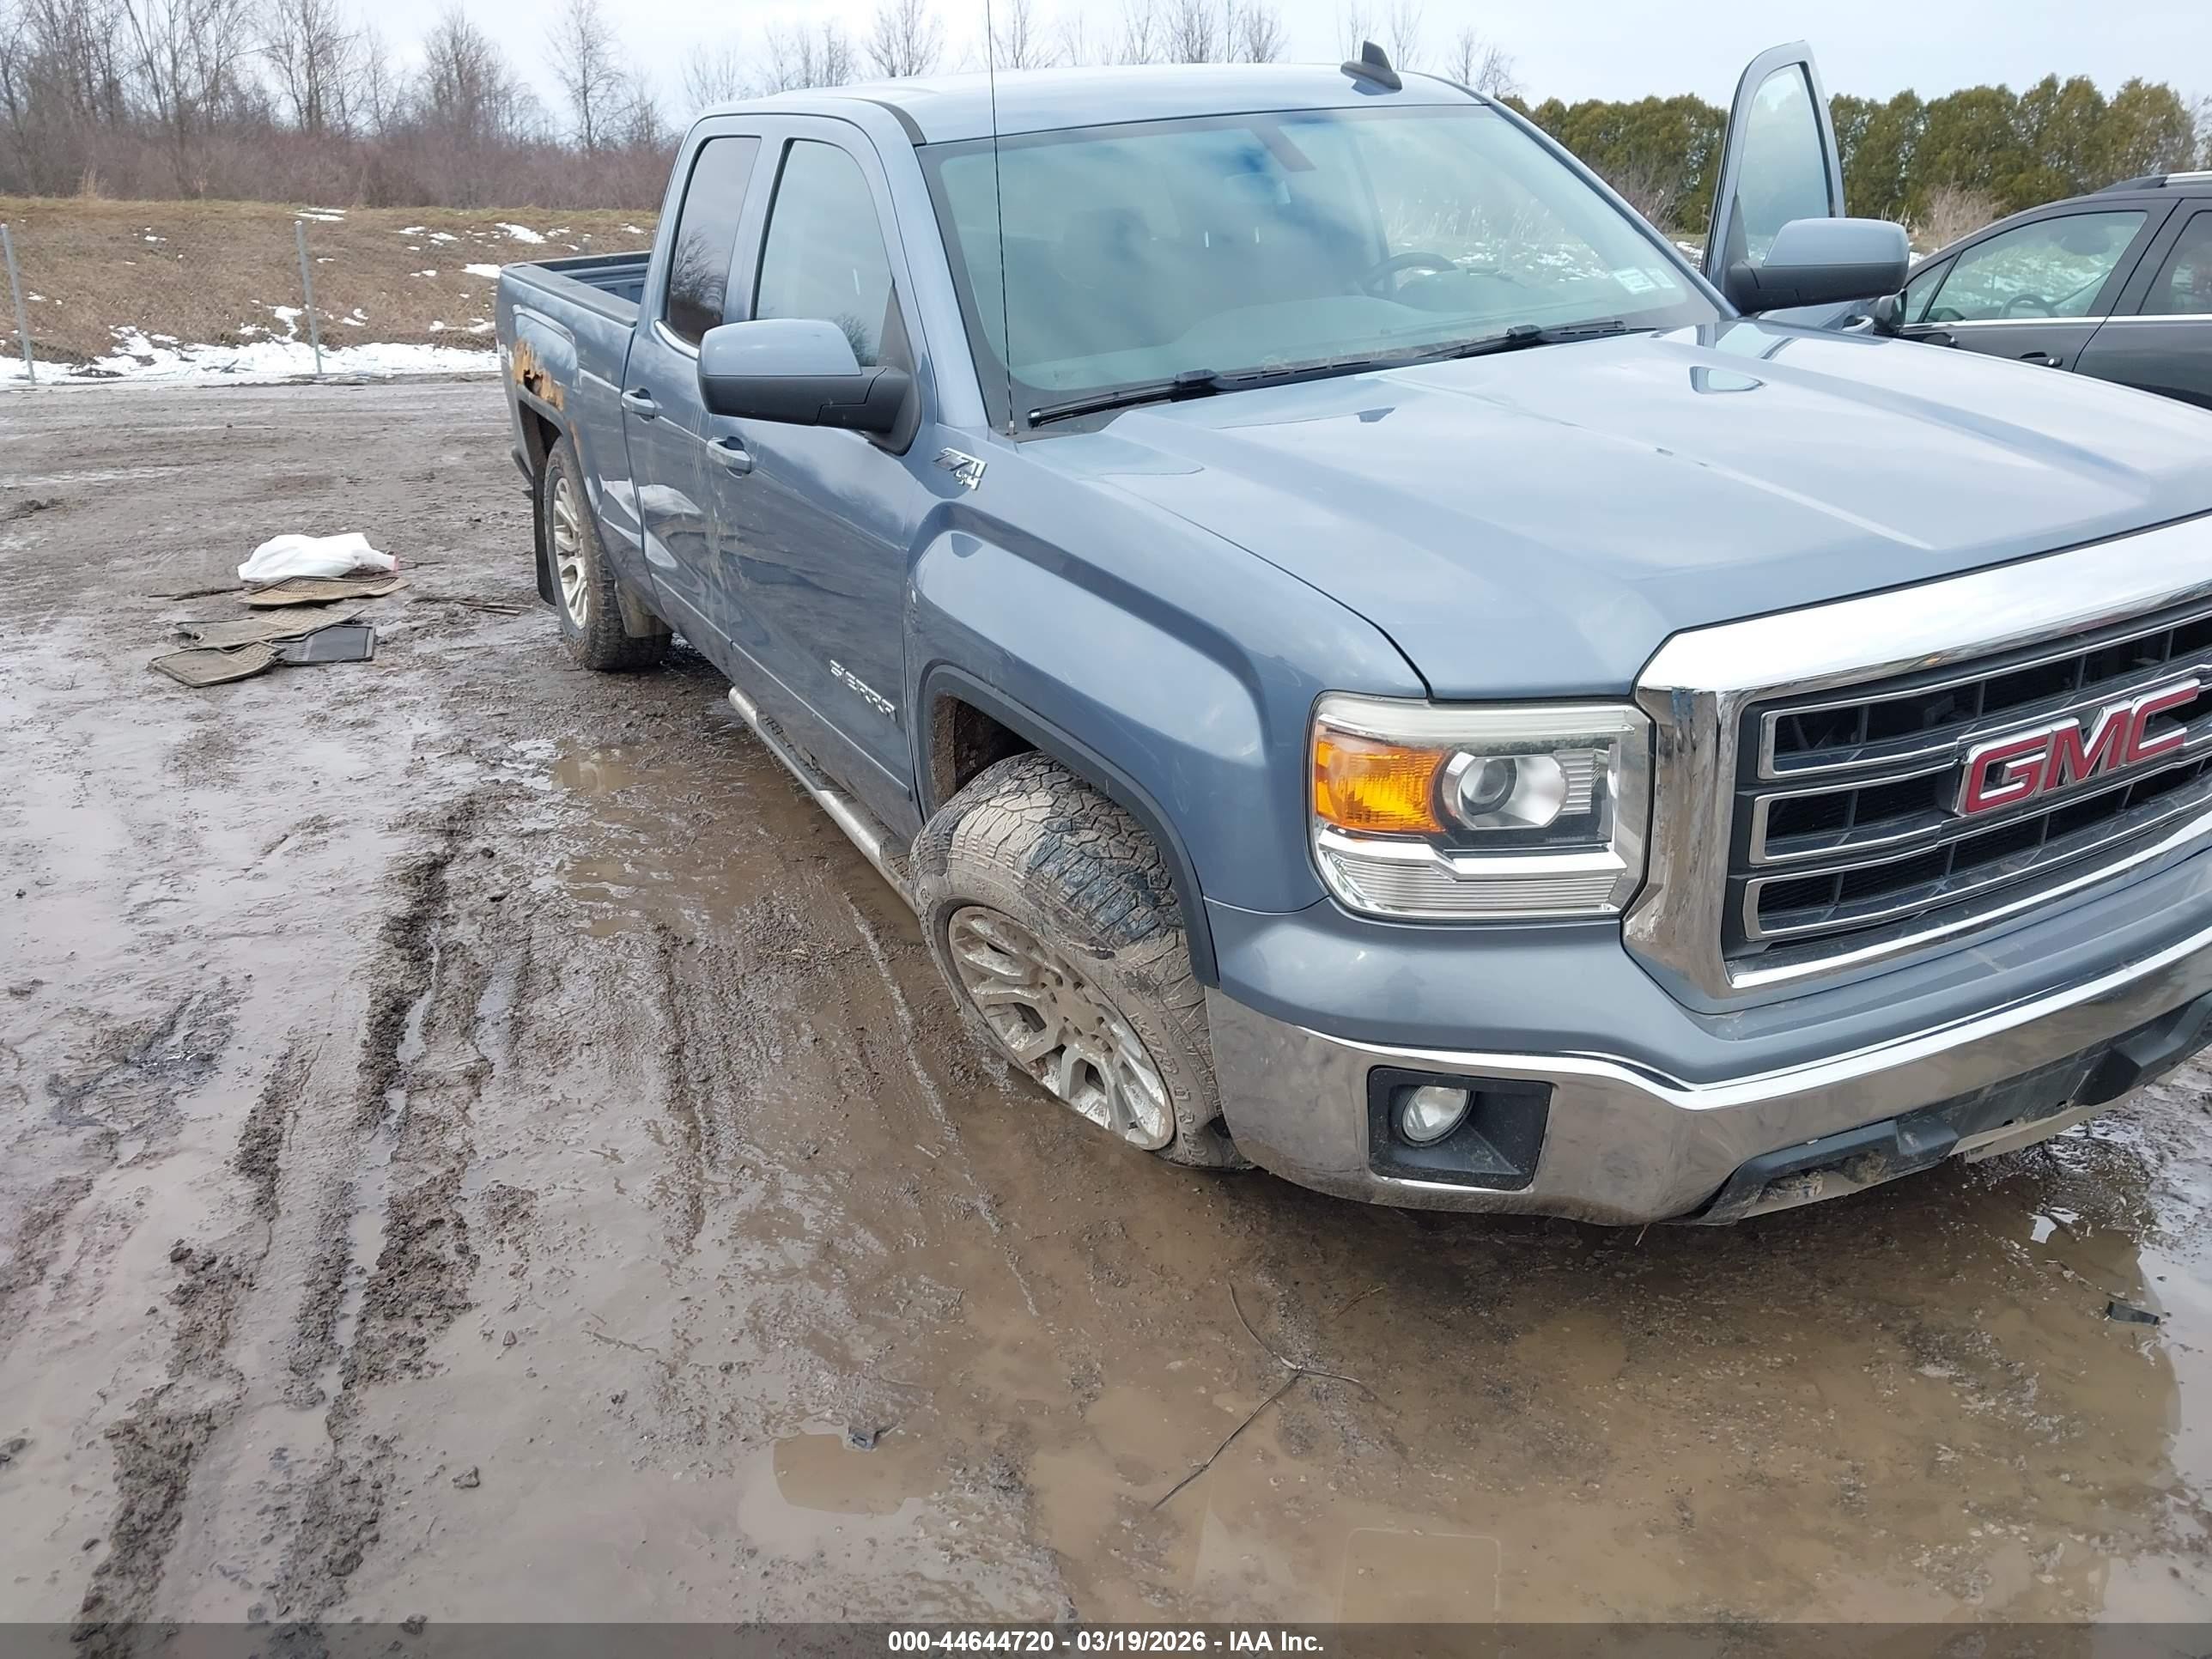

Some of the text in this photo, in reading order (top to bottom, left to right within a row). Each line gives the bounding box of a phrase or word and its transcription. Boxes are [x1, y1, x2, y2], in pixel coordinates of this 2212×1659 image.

[933, 447, 988, 478] Z71
[829, 659, 896, 721] SIERRA
[1954, 677, 2202, 817] GMC
